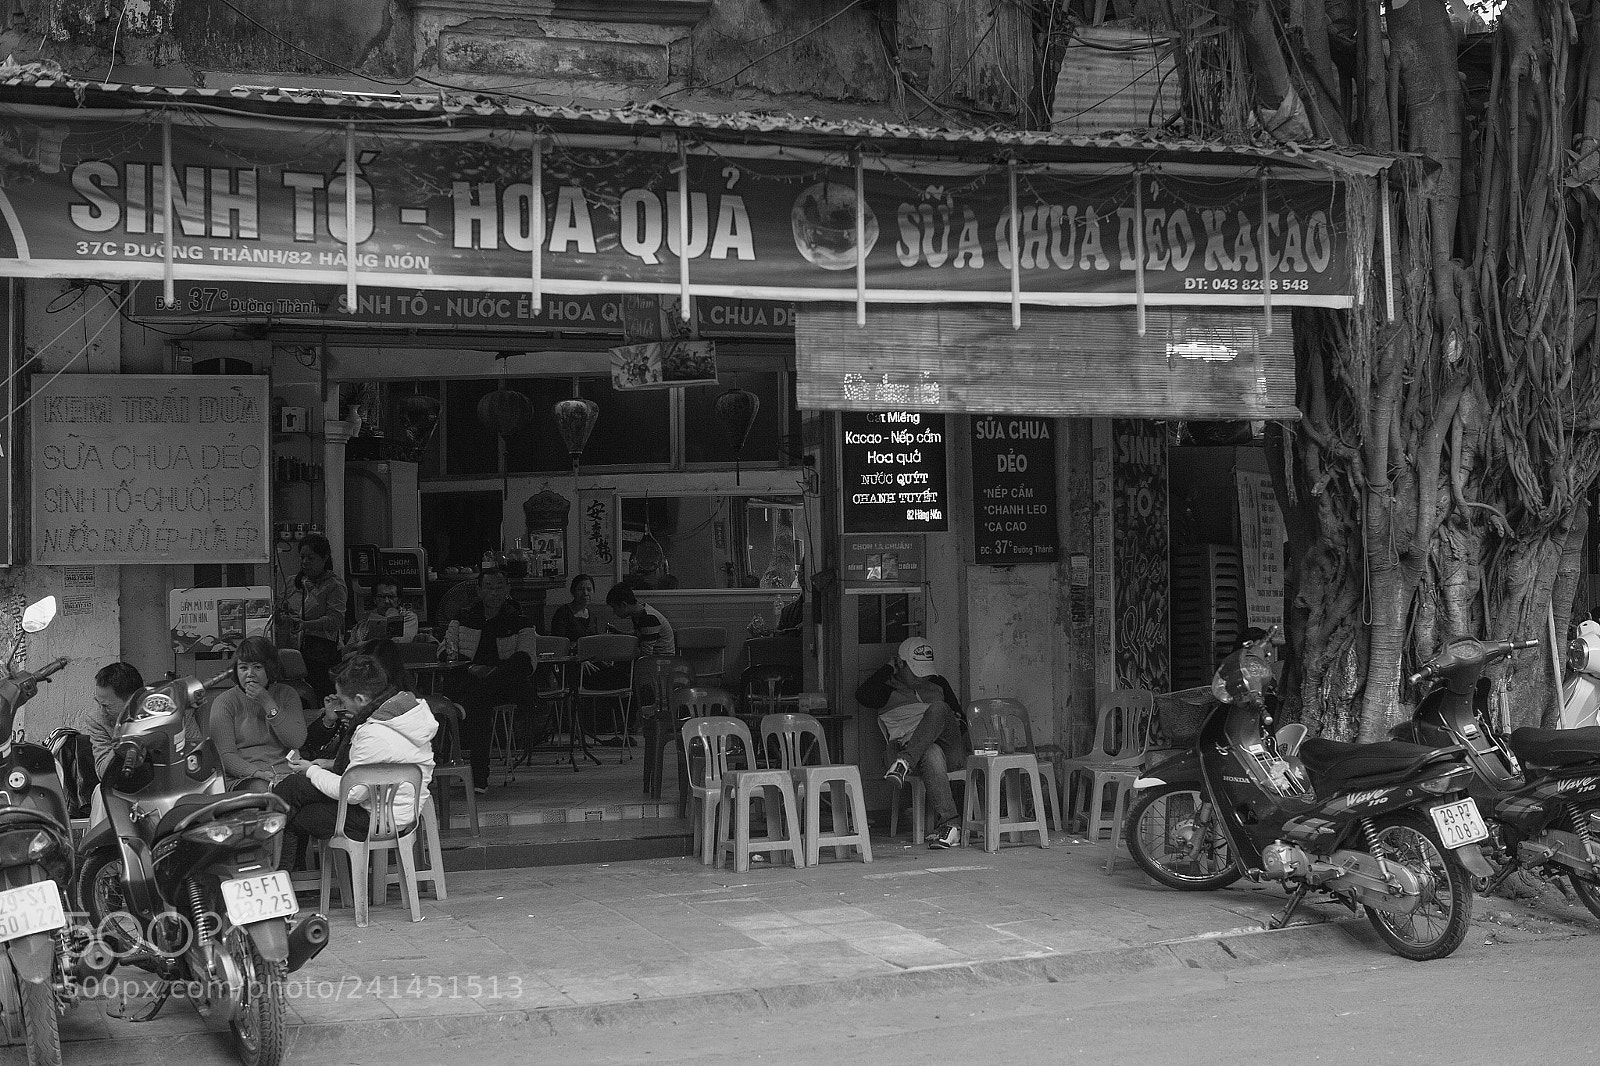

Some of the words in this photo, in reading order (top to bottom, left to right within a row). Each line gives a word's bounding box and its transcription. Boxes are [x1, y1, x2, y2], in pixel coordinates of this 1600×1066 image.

[71, 161, 258, 238] SINH
[283, 151, 379, 243] TỐ
[452, 181, 596, 253] HOA
[620, 167, 755, 265] QUẢ
[896, 185, 984, 268] SỮA
[995, 205, 1110, 270] CHUA
[1117, 182, 1195, 271] DẺO
[76, 241, 117, 255] 37C
[209, 244, 312, 265] THÀNH/82
[319, 249, 379, 267] HÀNG
[385, 252, 429, 269] NÓN
[1185, 277, 1208, 290] ĐT:
[1212, 278, 1238, 290] 043
[1282, 279, 1309, 290] 548
[276, 298, 320, 314] Thành
[337, 293, 391, 315] SNH
[548, 301, 596, 322] HOA
[710, 305, 768, 326] CHUA
[44, 396, 111, 423] KEM
[845, 430, 882, 445] Kacao
[891, 428, 914, 446] Nếp
[976, 415, 1006, 439] SỮA
[1008, 420, 1050, 440] CHUA
[43, 433, 104, 470] SỮA
[112, 445, 194, 470] CHUA
[202, 433, 261, 470] DẺO
[867, 450, 894, 464] Hoa
[896, 448, 922, 466] quả
[997, 447, 1028, 473] DẺO
[1119, 435, 1161, 466] SINH
[44, 486, 96, 512] SINH
[1026, 504, 1048, 515] LEO
[906, 509, 915, 521] 82
[1005, 521, 1027, 532] CAO
[1222, 775, 1251, 784] HONDA
[1556, 776, 1598, 792] Wave
[1346, 788, 1392, 807] Wave
[234, 875, 280, 900] 29-F1
